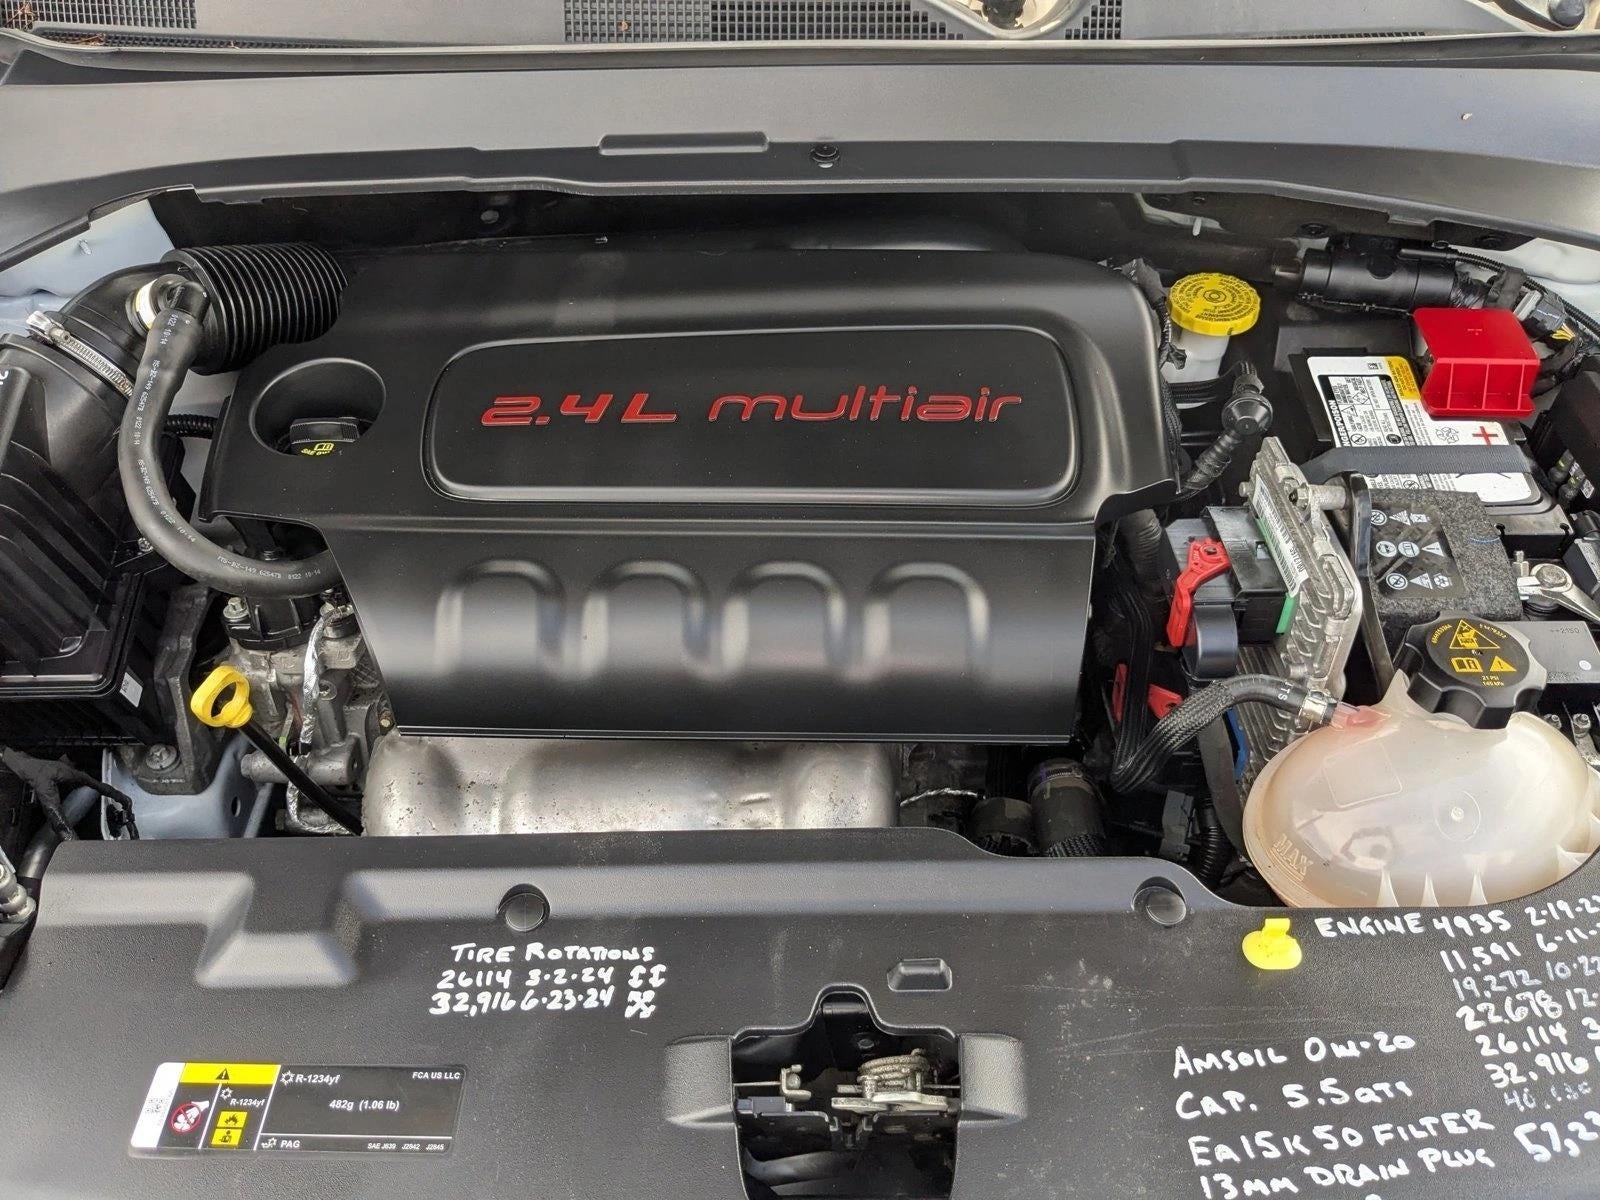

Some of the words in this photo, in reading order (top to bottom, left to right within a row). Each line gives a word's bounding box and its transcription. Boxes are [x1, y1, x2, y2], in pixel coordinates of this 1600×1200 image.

[708, 385, 1022, 422] multiair
[1314, 912, 1425, 938] ENGINE
[1432, 909, 1512, 938] 4935
[451, 942, 516, 963] TIRE
[525, 941, 655, 962] ROTATIONS
[436, 968, 513, 990] 26114
[1173, 1045, 1288, 1079] AMSOIL
[295, 1074, 340, 1086] R-1234yf
[412, 1071, 429, 1080] FCA
[430, 1071, 444, 1080] US
[444, 1071, 461, 1080] LLC
[229, 1098, 266, 1108] R-1234yf
[329, 1099, 354, 1111] 482g
[359, 1099, 384, 1112] (1.06
[385, 1099, 400, 1112] lb)
[1371, 1108, 1496, 1147] FILTER
[280, 1139, 300, 1149] PAG
[367, 1142, 381, 1150] SAE
[1303, 1157, 1410, 1187] DRAIN
[1416, 1147, 1496, 1173] PLUG
